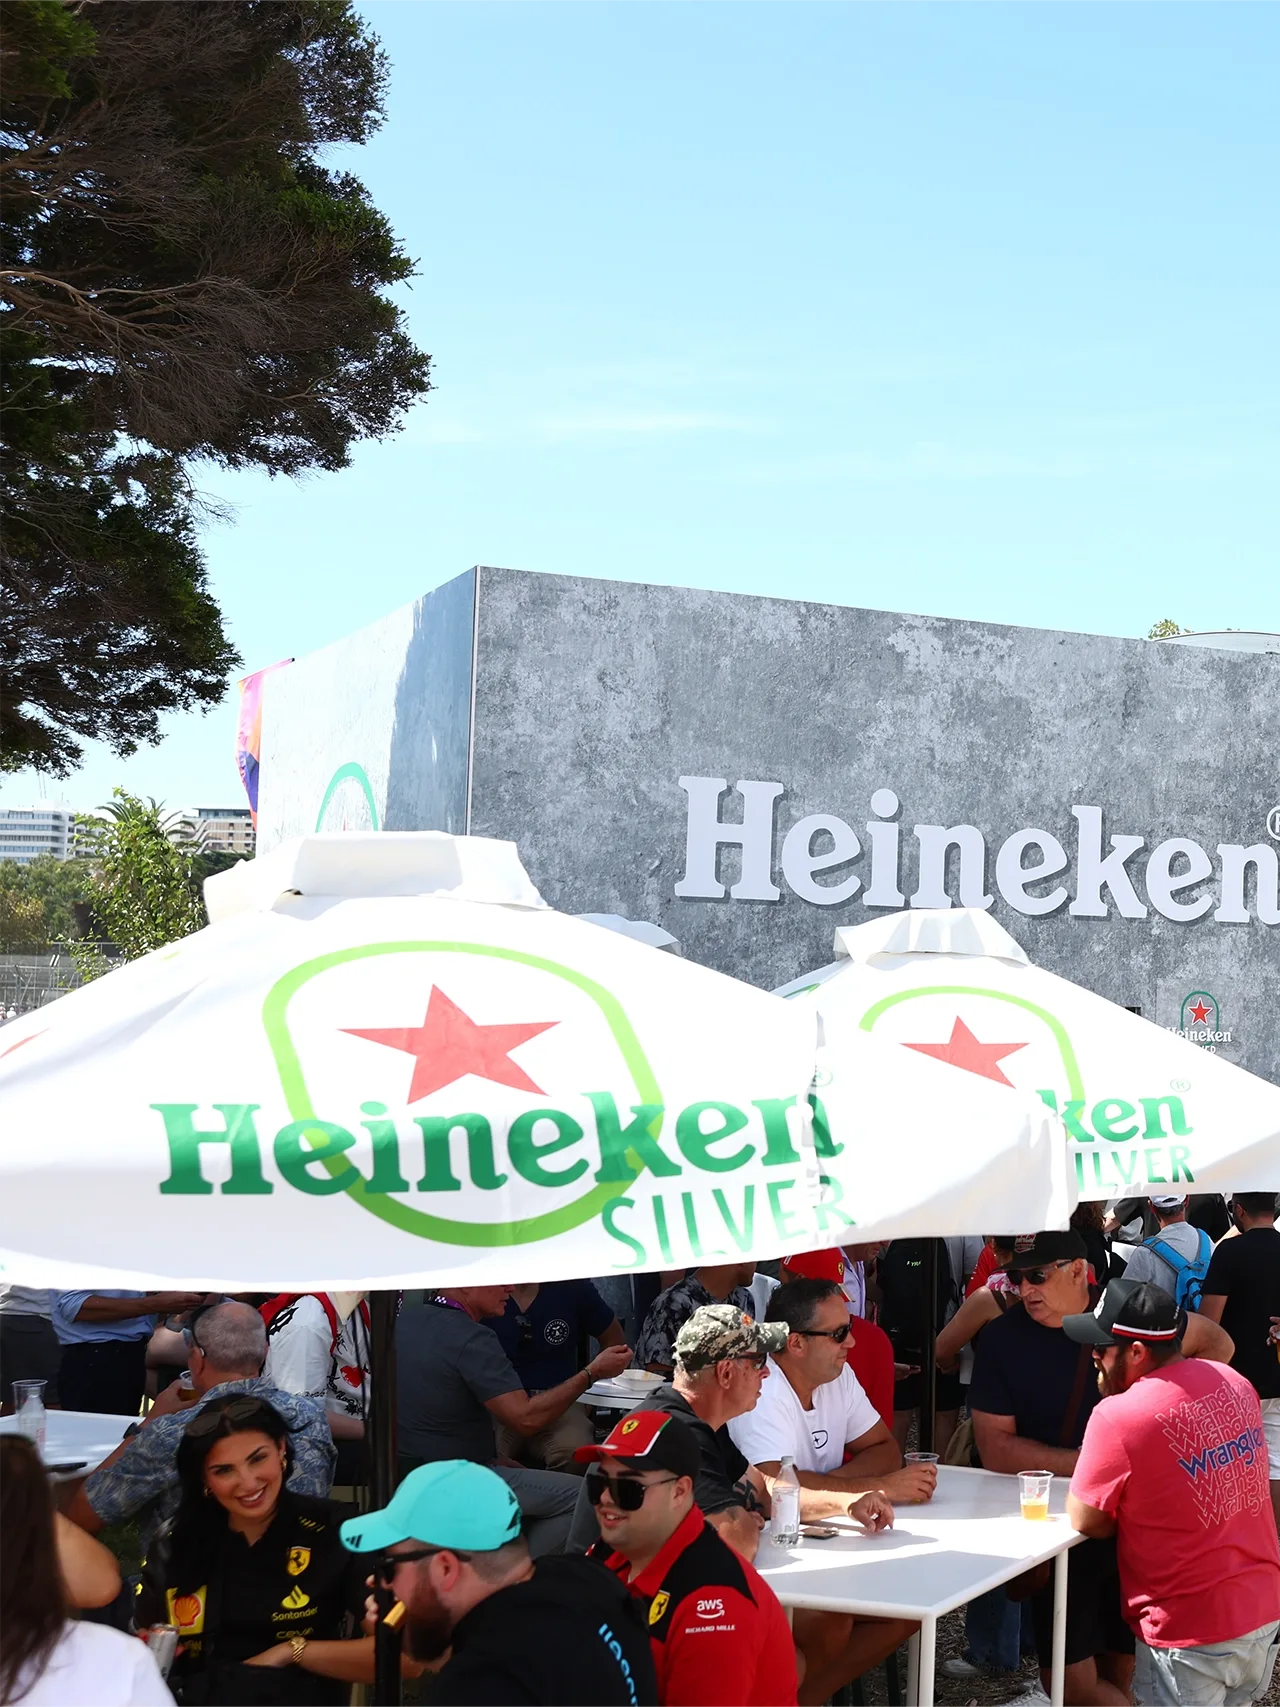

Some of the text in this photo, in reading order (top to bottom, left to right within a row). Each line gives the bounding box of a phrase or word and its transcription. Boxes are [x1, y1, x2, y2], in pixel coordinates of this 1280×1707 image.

[149, 1091, 845, 1195] Heineken
[1074, 1145, 1195, 1193] ILVER
[601, 1175, 856, 1269] SILVER
[1177, 1427, 1263, 1479] Wrangle
[272, 1606, 318, 1622] Santander
[697, 1599, 724, 1611] aws
[685, 1625, 715, 1634] RICHARD
